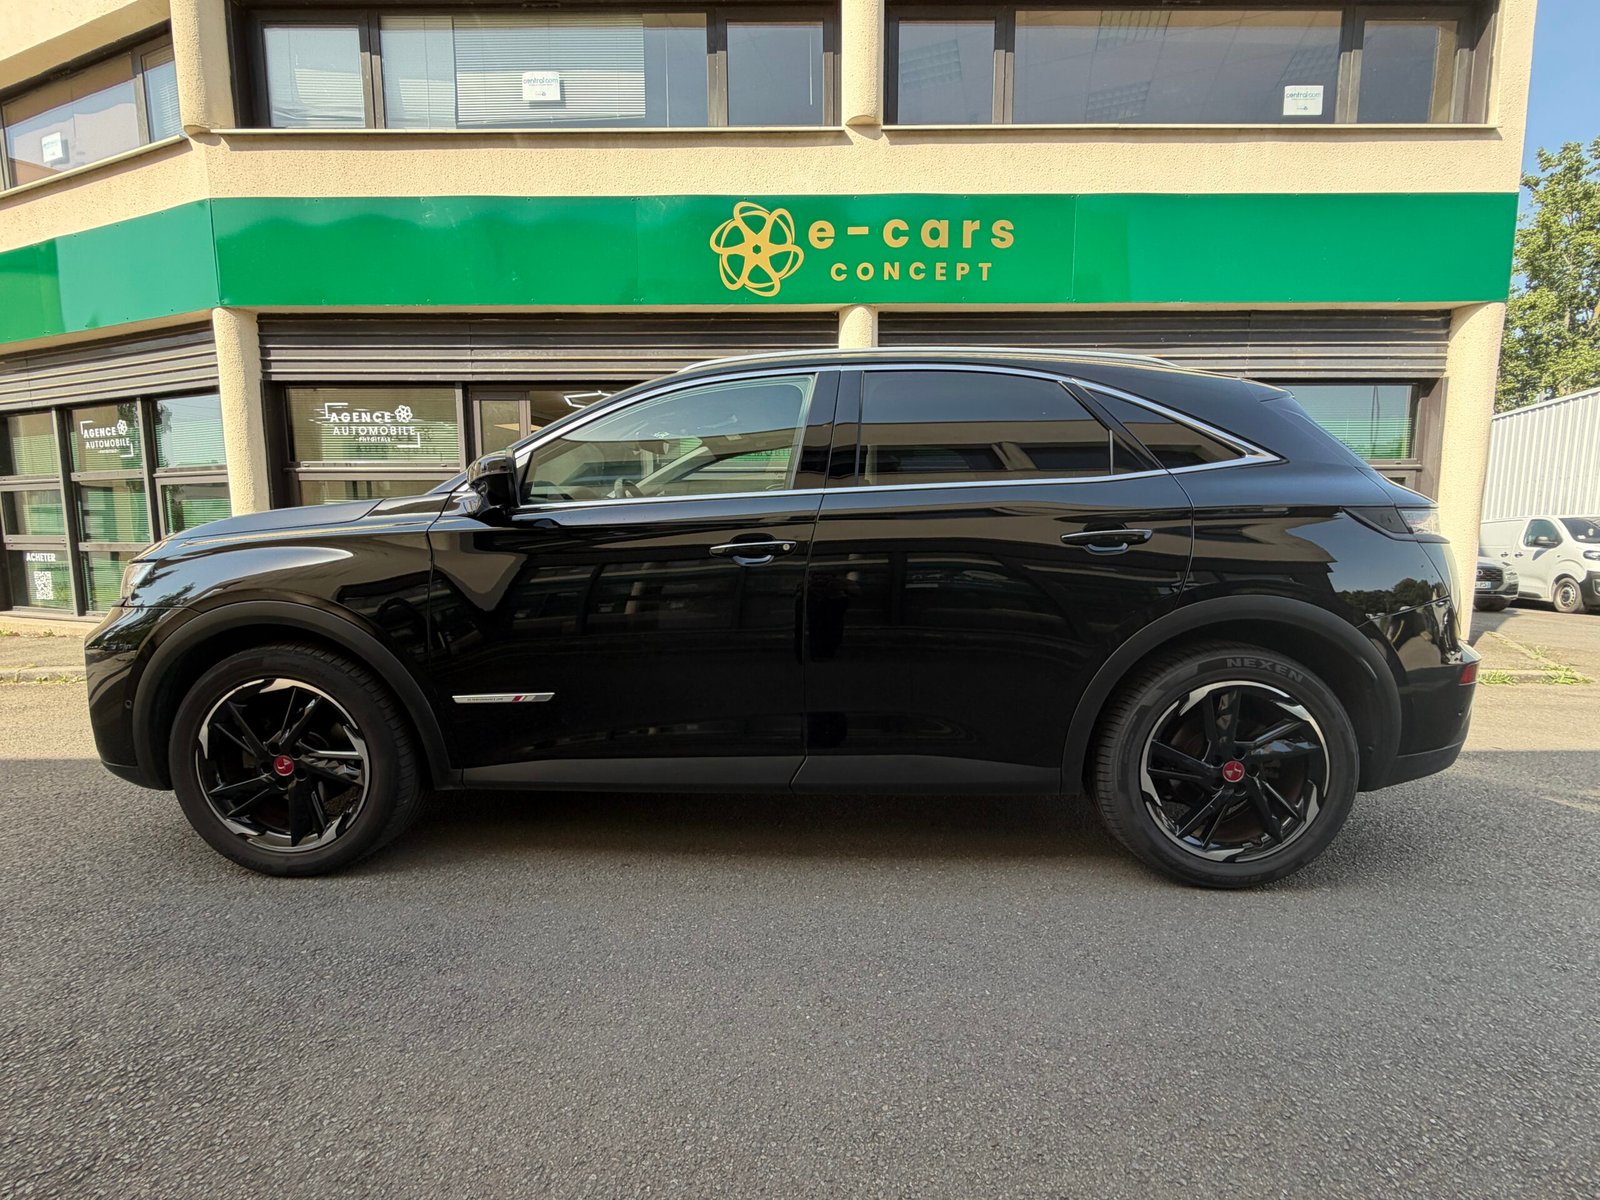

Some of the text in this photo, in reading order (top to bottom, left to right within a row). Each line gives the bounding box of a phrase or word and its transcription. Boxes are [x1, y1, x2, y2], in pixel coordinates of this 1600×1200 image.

[808, 218, 1015, 249] e-cars
[830, 262, 992, 281] CONCEPT
[330, 412, 392, 422] AGENCE
[83, 427, 117, 439] AGENCE
[333, 426, 415, 435] AUTOMOBILE
[86, 438, 130, 449] AUTOMOBILE
[26, 552, 56, 562] ACHETER
[1226, 659, 1303, 682] NEXEN
